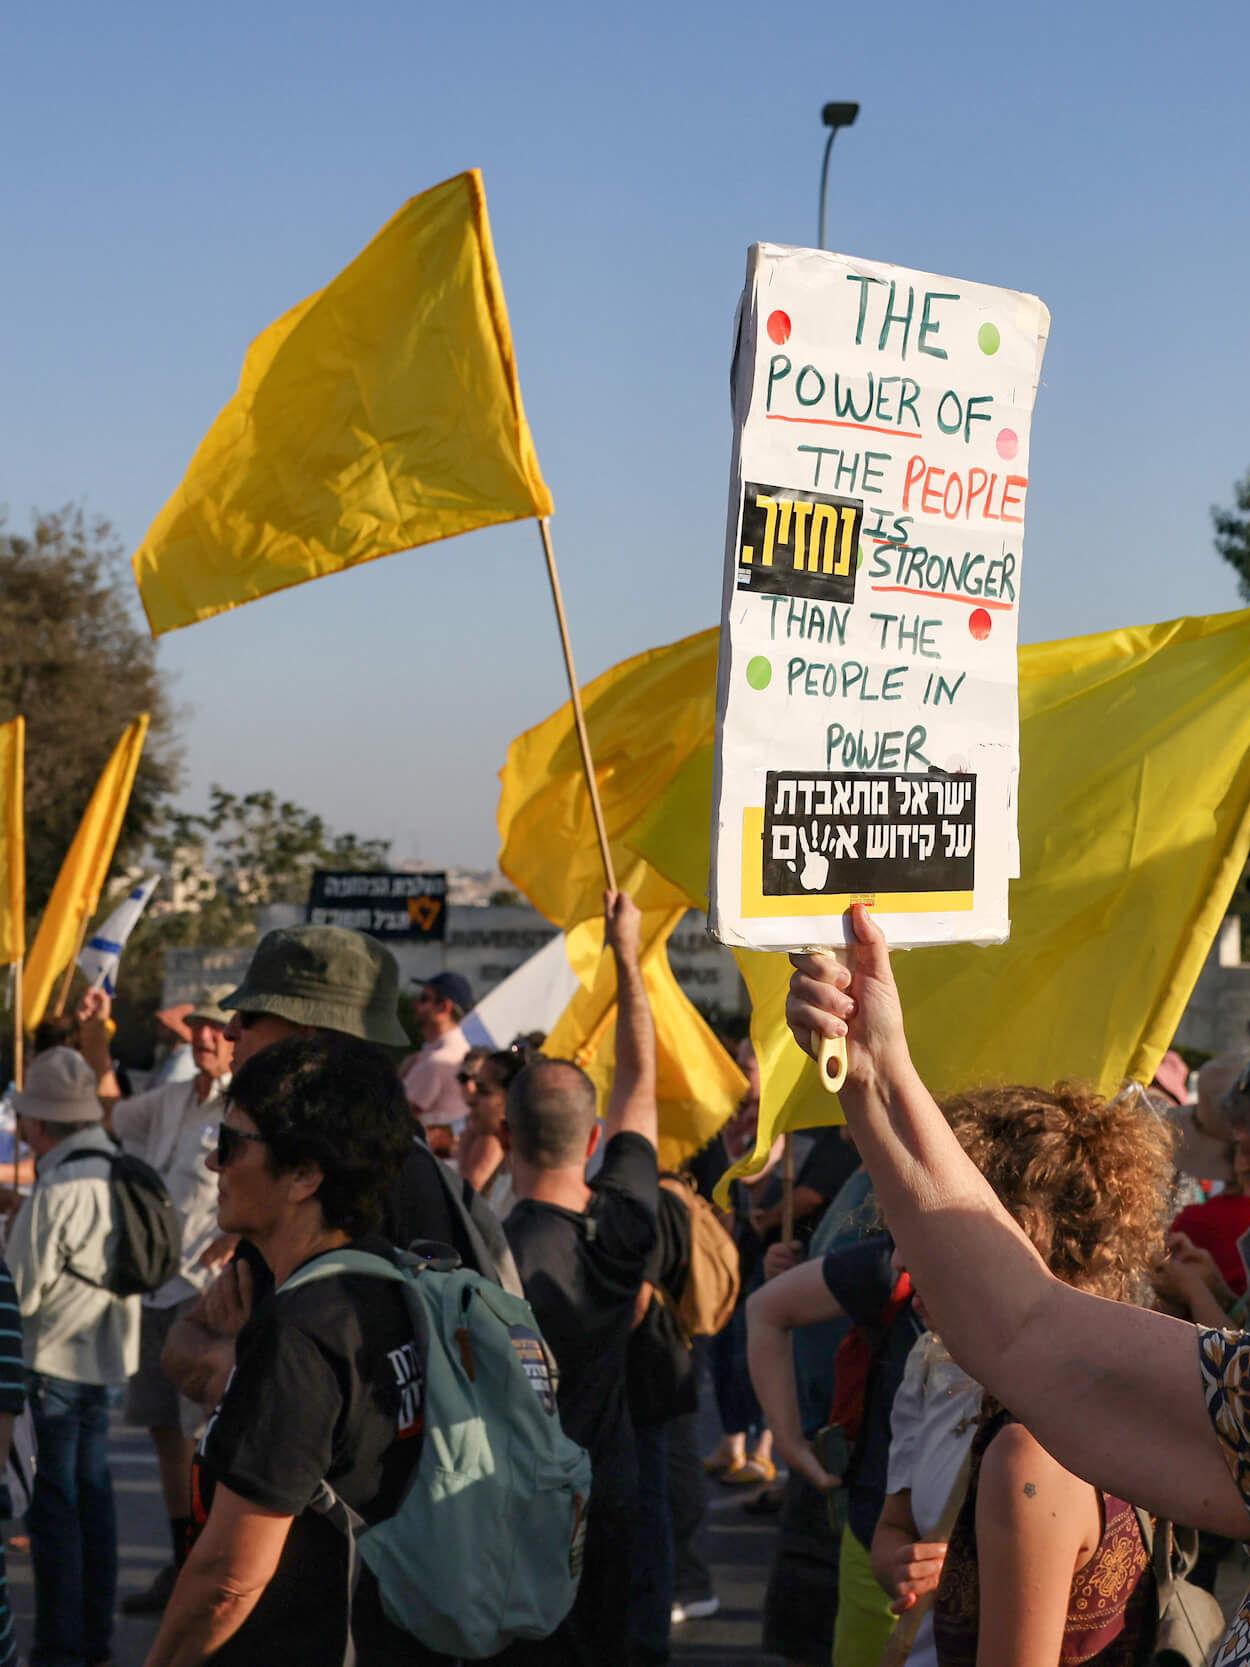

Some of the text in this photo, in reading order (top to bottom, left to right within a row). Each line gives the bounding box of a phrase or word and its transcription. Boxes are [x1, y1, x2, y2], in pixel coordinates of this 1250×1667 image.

[846, 274, 960, 361] THE
[766, 354, 994, 443] POWER OF
[797, 445, 1029, 523] THE PEOPLE
[741, 494, 857, 577] נחזיר.
[862, 507, 914, 544] IS
[868, 544, 1016, 602] STRONGER
[761, 595, 943, 660] THAN THE
[787, 657, 967, 706] PEOPLE IN
[826, 722, 932, 771] POWER
[773, 777, 972, 815] ישראל מתאבדת
[865, 824, 936, 861] קידוש
[941, 820, 973, 859] על
